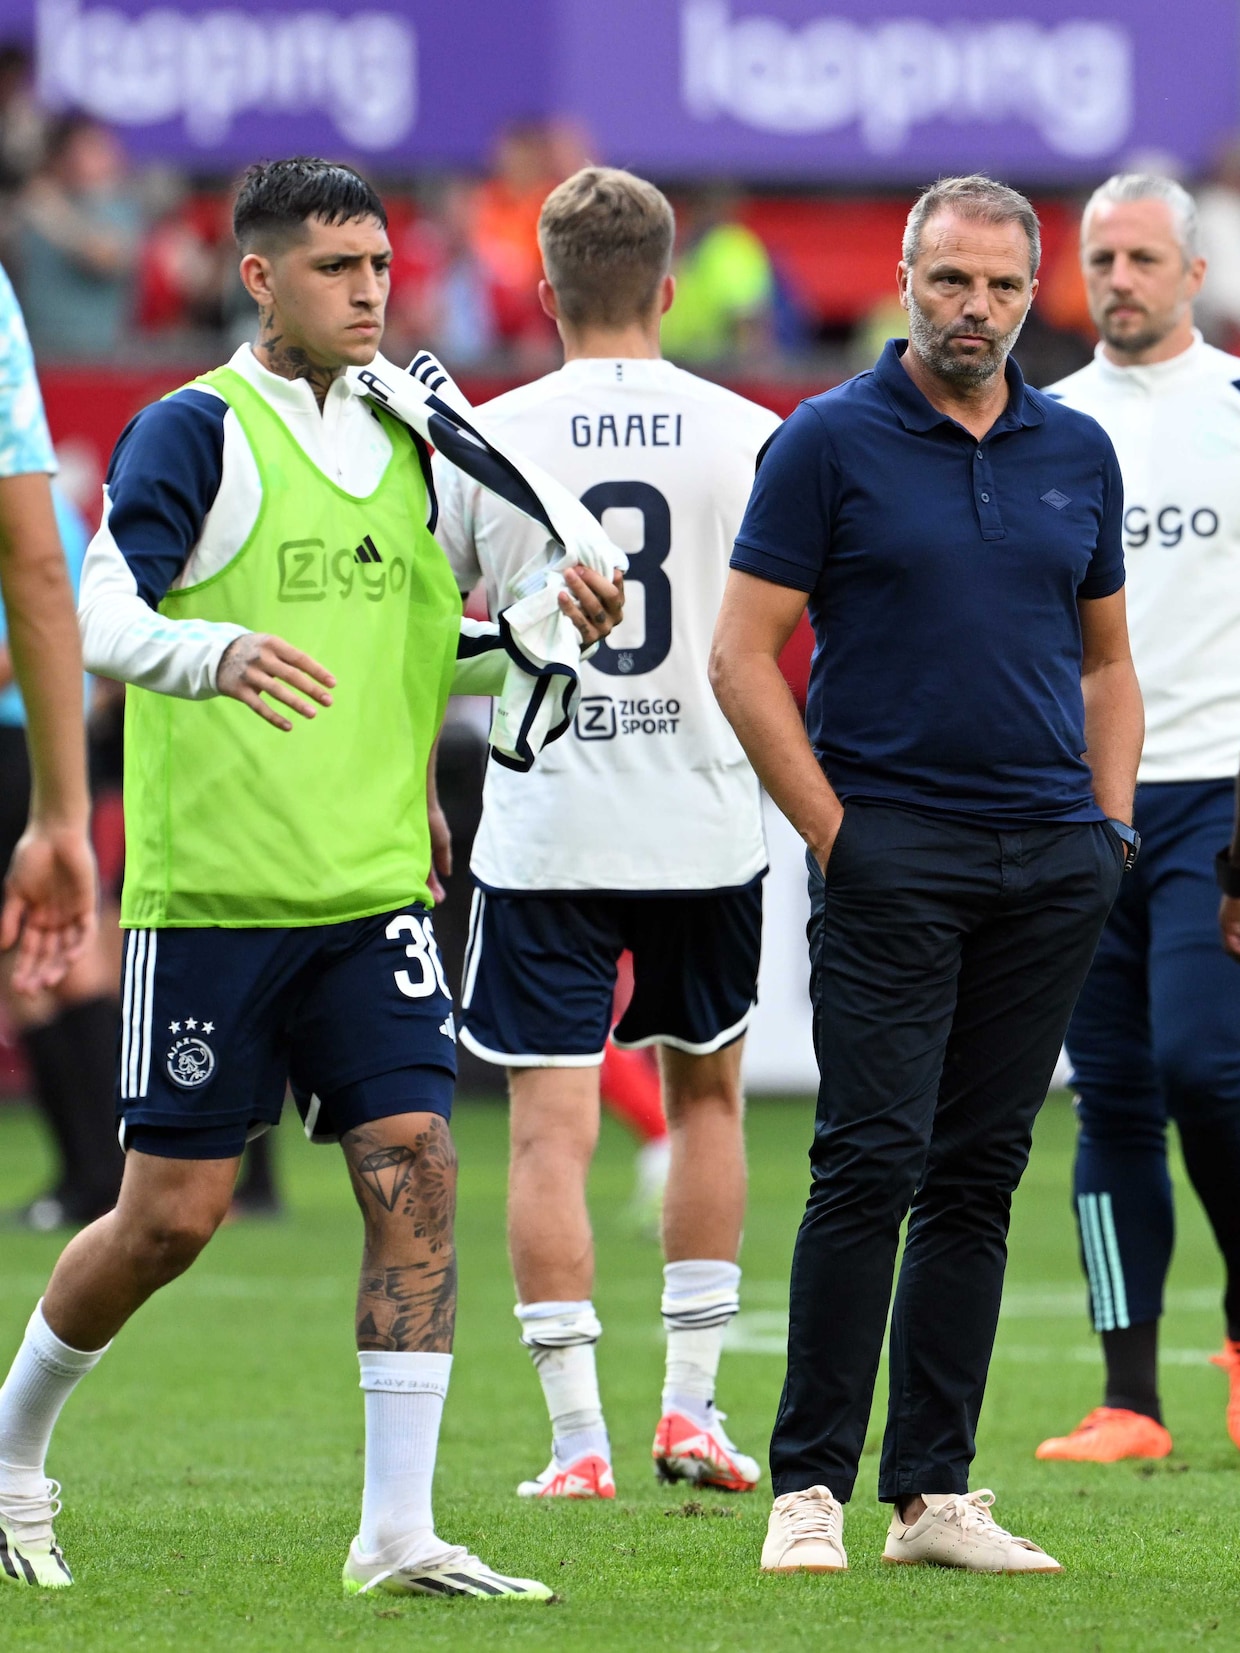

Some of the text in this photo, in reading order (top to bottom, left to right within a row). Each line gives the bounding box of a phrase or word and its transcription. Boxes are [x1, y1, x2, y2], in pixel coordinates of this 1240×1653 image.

[571, 413, 682, 447] GAAEI
[1123, 505, 1219, 549] ggo
[619, 699, 680, 715] ZIGGO
[621, 718, 680, 734] SPORT
[167, 1036, 190, 1060] AJAX
